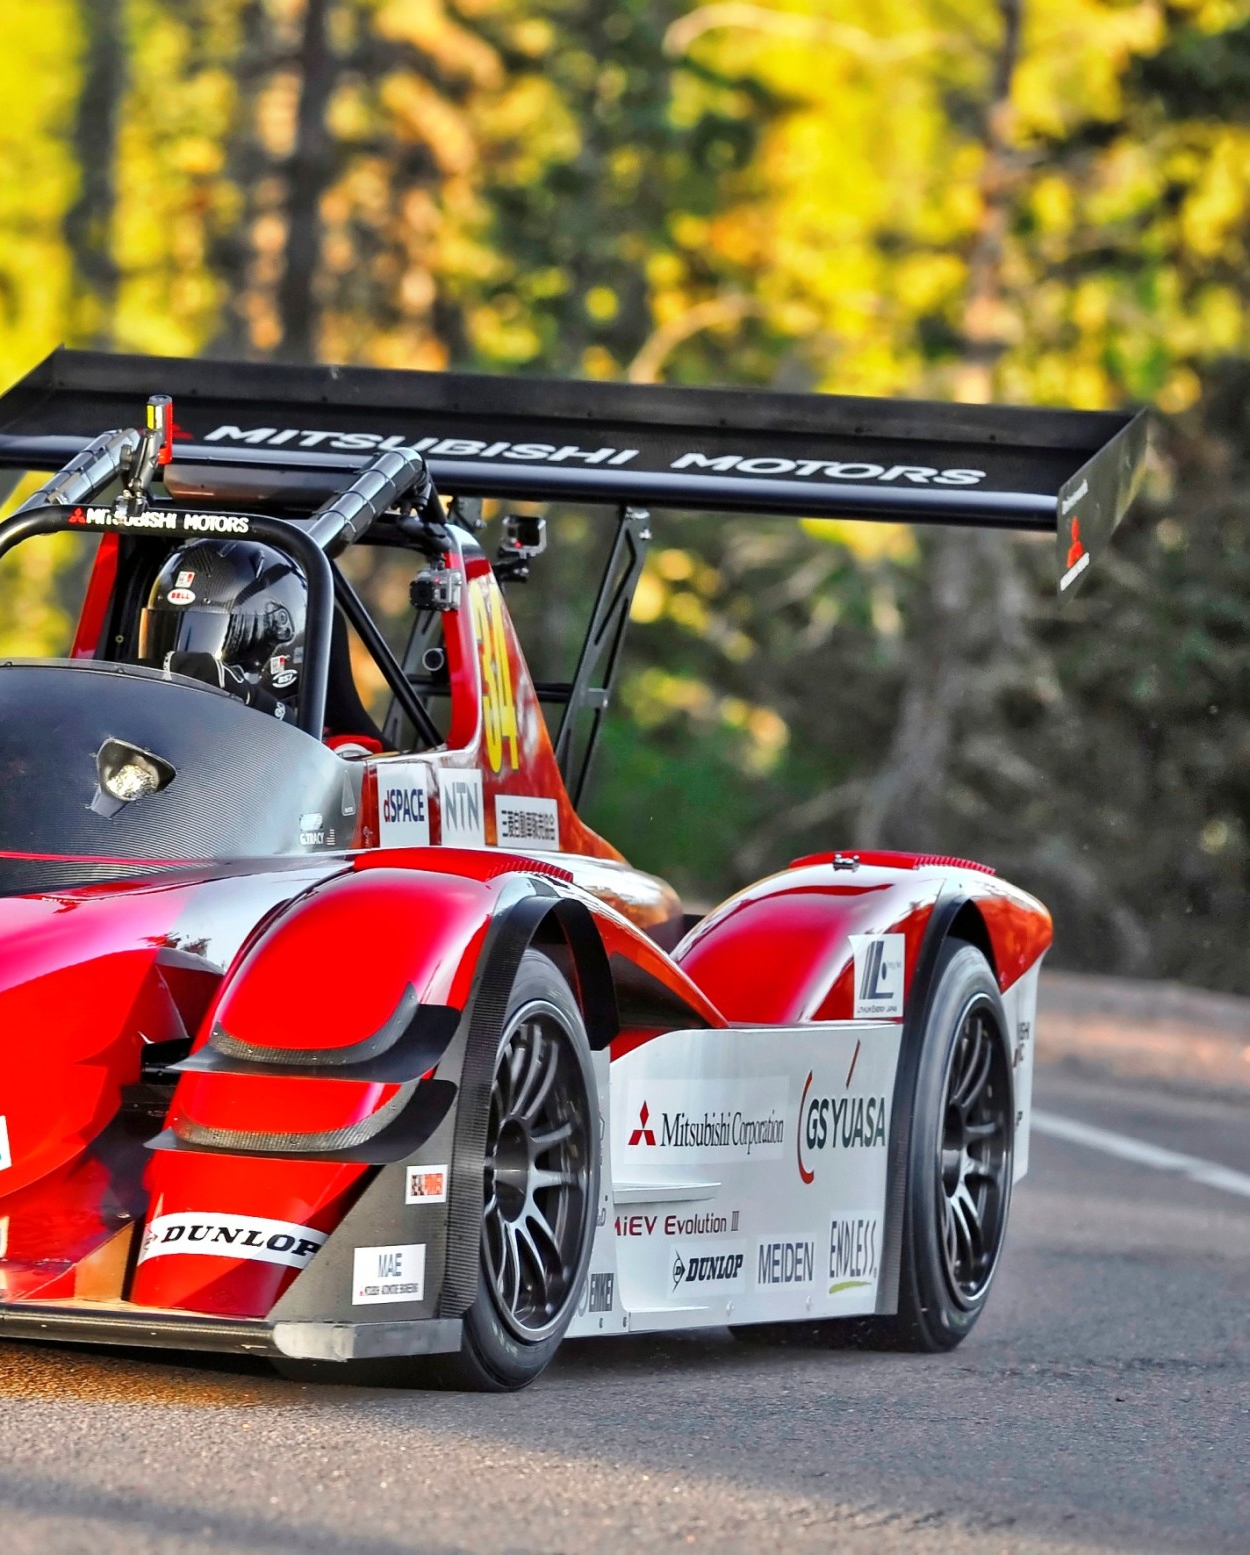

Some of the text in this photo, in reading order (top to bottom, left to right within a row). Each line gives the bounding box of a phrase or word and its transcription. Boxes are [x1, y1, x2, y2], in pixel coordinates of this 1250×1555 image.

[203, 425, 987, 485] MITSUBISHI MOTORS
[184, 514, 250, 533] MOTORS
[171, 591, 191, 600] BELL
[468, 578, 520, 773] 34
[383, 788, 425, 823] dSPACE
[444, 782, 480, 832] NTN
[660, 1109, 785, 1155] Mitsubishi Corporation
[806, 1096, 886, 1150] GS YUASA
[161, 1225, 322, 1257] DUNLOP
[664, 1213, 727, 1235] Evolution
[378, 1253, 403, 1278] MAE
[685, 1253, 744, 1282] DUNLOP
[758, 1241, 815, 1285] MEIDEN
